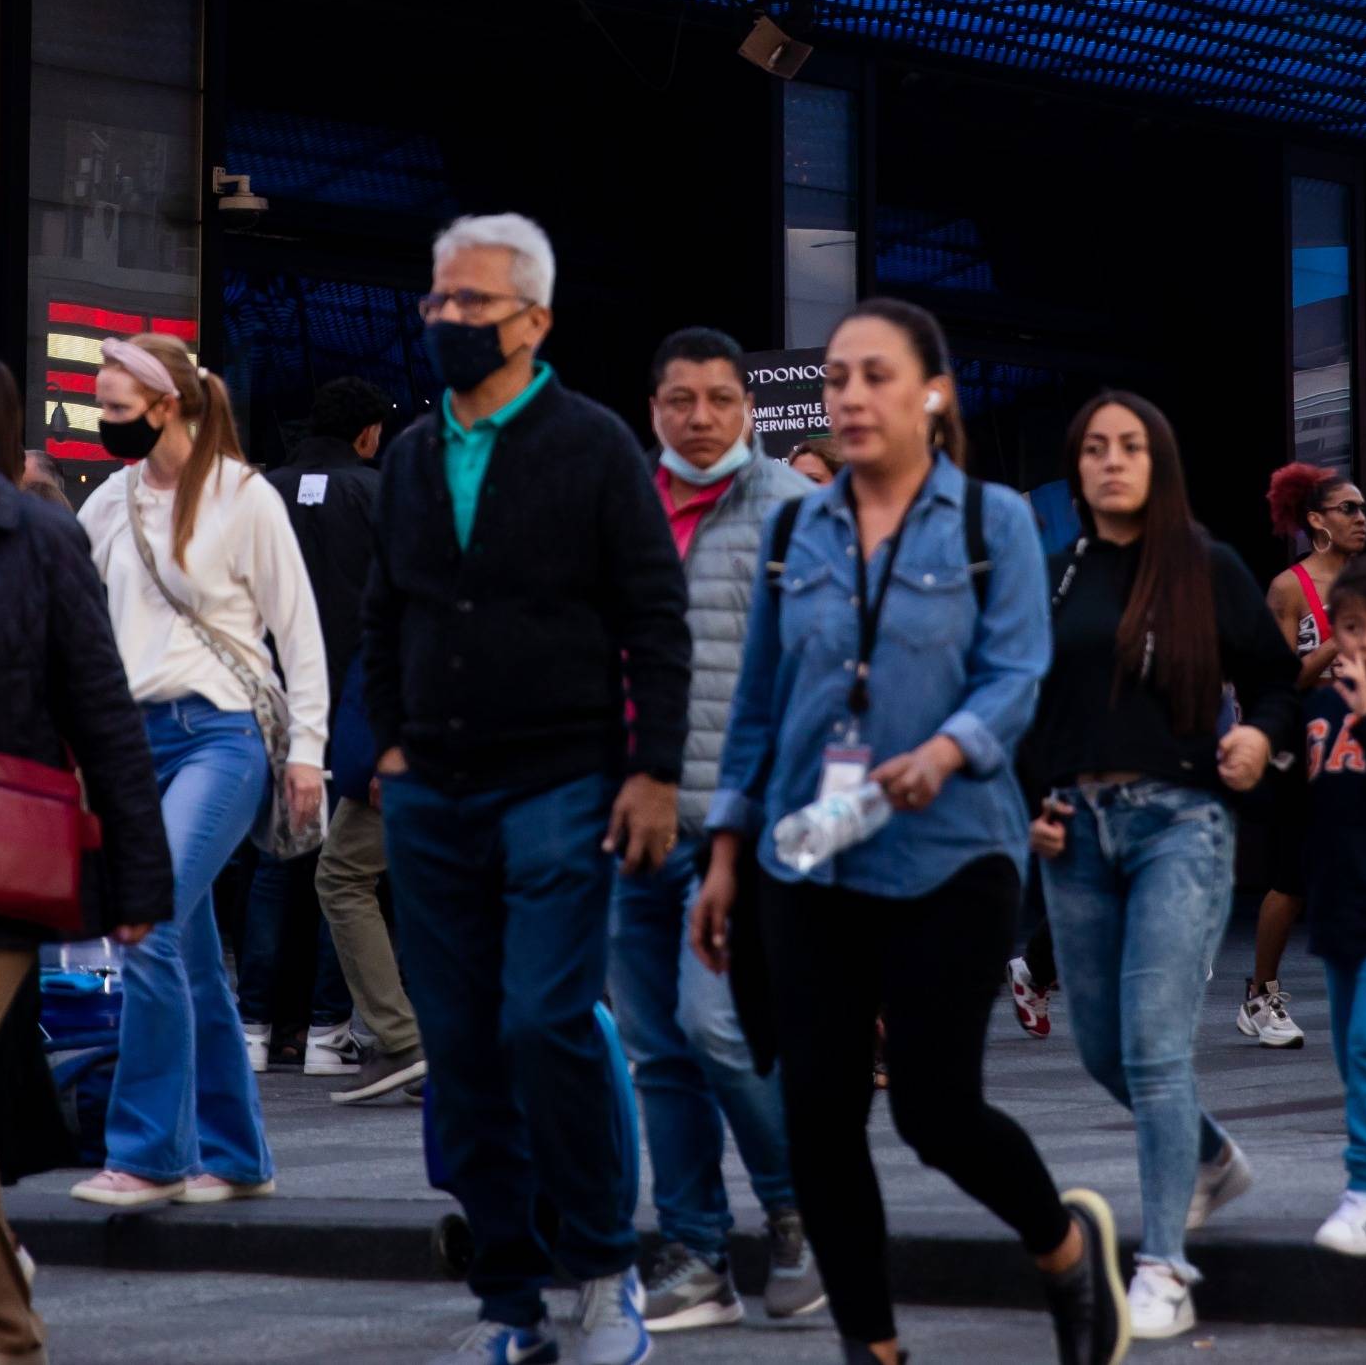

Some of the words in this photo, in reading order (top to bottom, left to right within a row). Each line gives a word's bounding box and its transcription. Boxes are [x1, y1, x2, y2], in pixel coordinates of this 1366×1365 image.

[751, 405, 784, 419] AMILY
[787, 403, 822, 416] STYLE
[755, 418, 805, 433] SERVING
[807, 415, 832, 429] FOO
